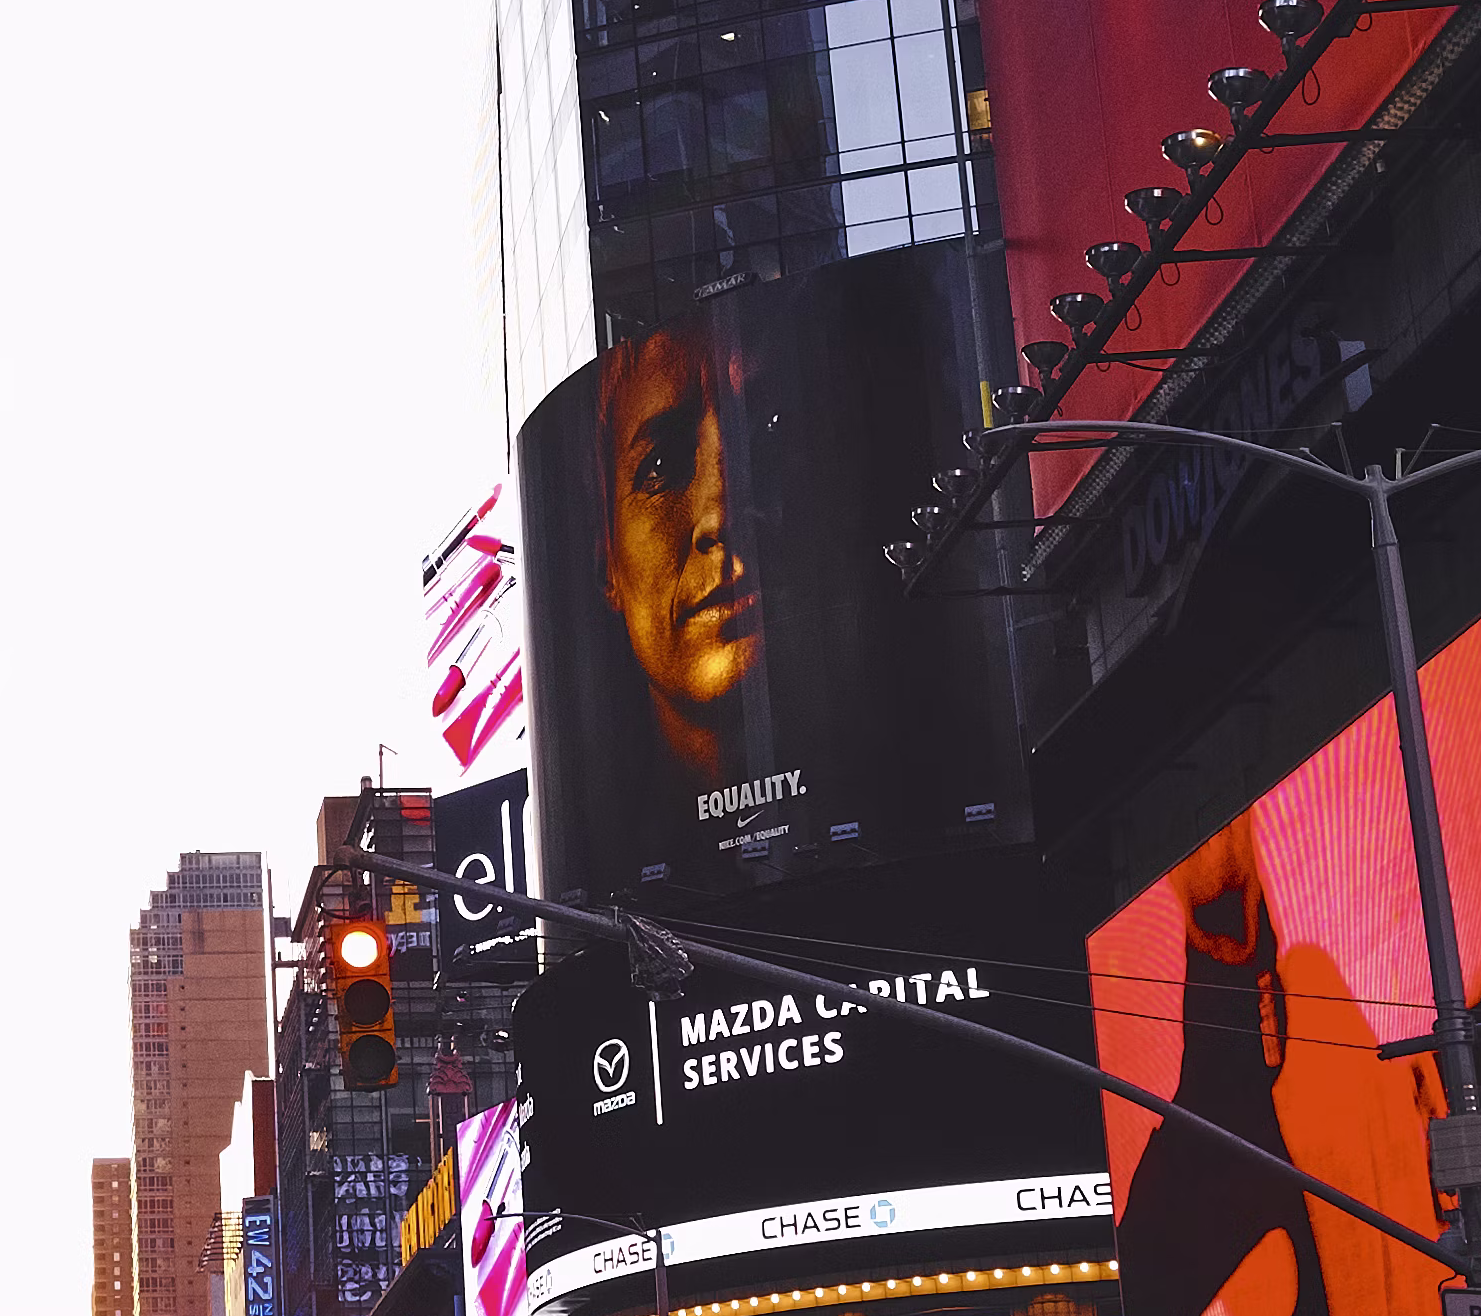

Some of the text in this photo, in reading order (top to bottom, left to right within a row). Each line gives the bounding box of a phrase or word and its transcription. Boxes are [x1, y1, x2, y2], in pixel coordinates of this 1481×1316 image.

[697, 769, 807, 820] EQUALITY.
[719, 825, 789, 851] NIKE.COM/EQUALITY
[680, 994, 802, 1047] MAZDA
[683, 1031, 845, 1090] SERVICES
[762, 1206, 861, 1240] CHASE
[248, 1249, 273, 1301] 42
[593, 1241, 653, 1273] CHASE
